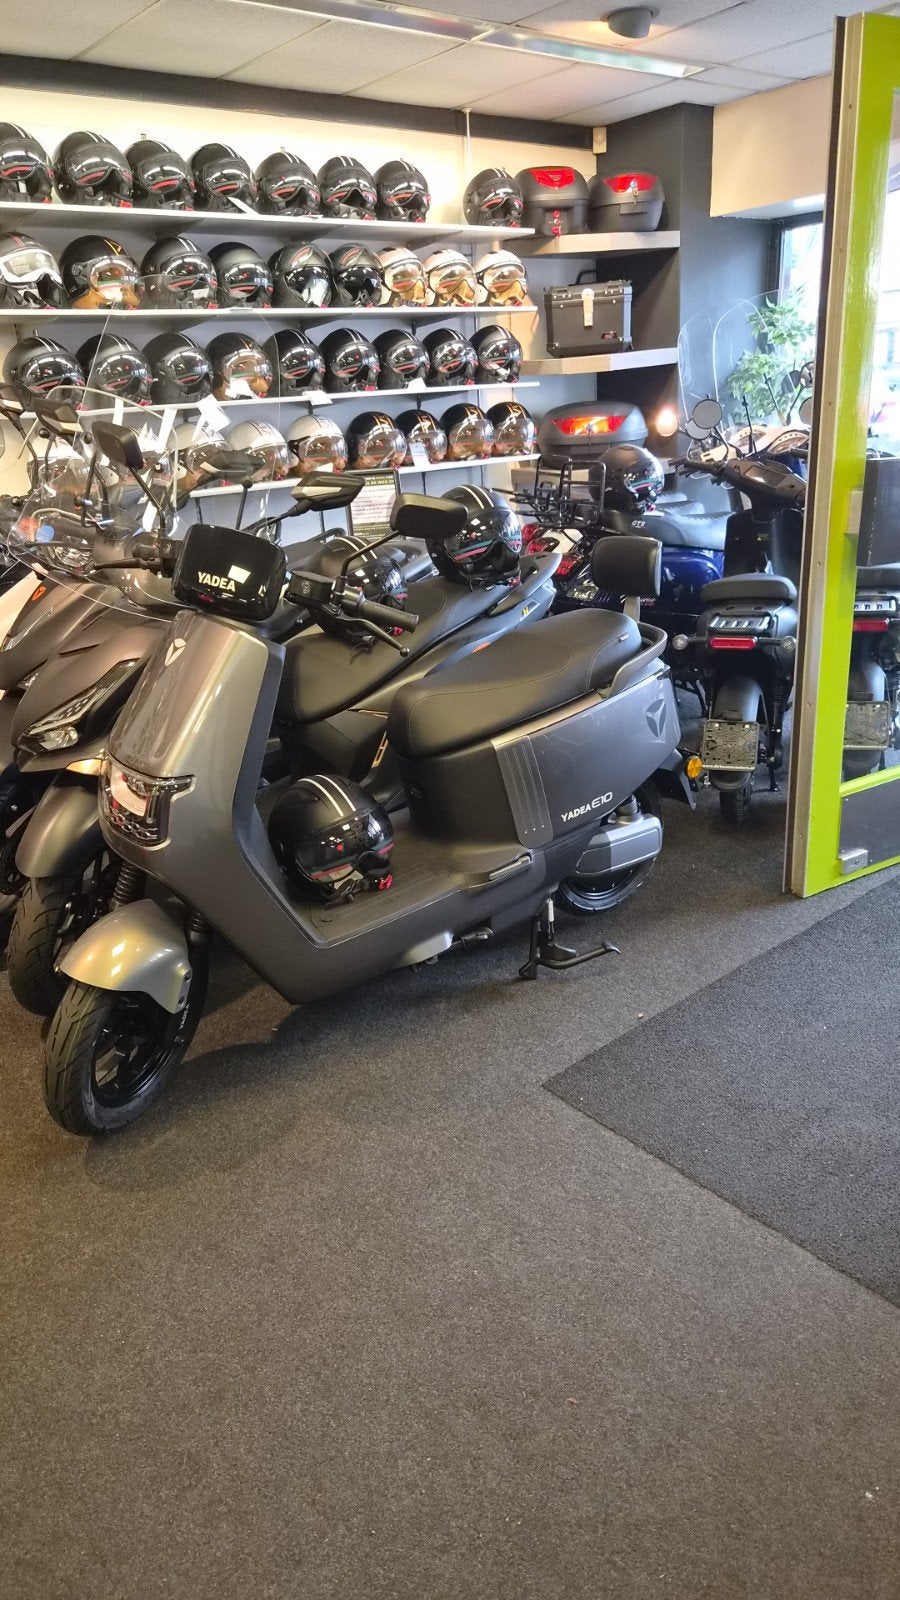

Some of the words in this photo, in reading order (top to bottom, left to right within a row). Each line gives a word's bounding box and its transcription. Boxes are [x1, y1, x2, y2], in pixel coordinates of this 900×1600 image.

[197, 571, 236, 592] YADEA
[561, 803, 592, 822] YADEA
[591, 791, 613, 809] E10
